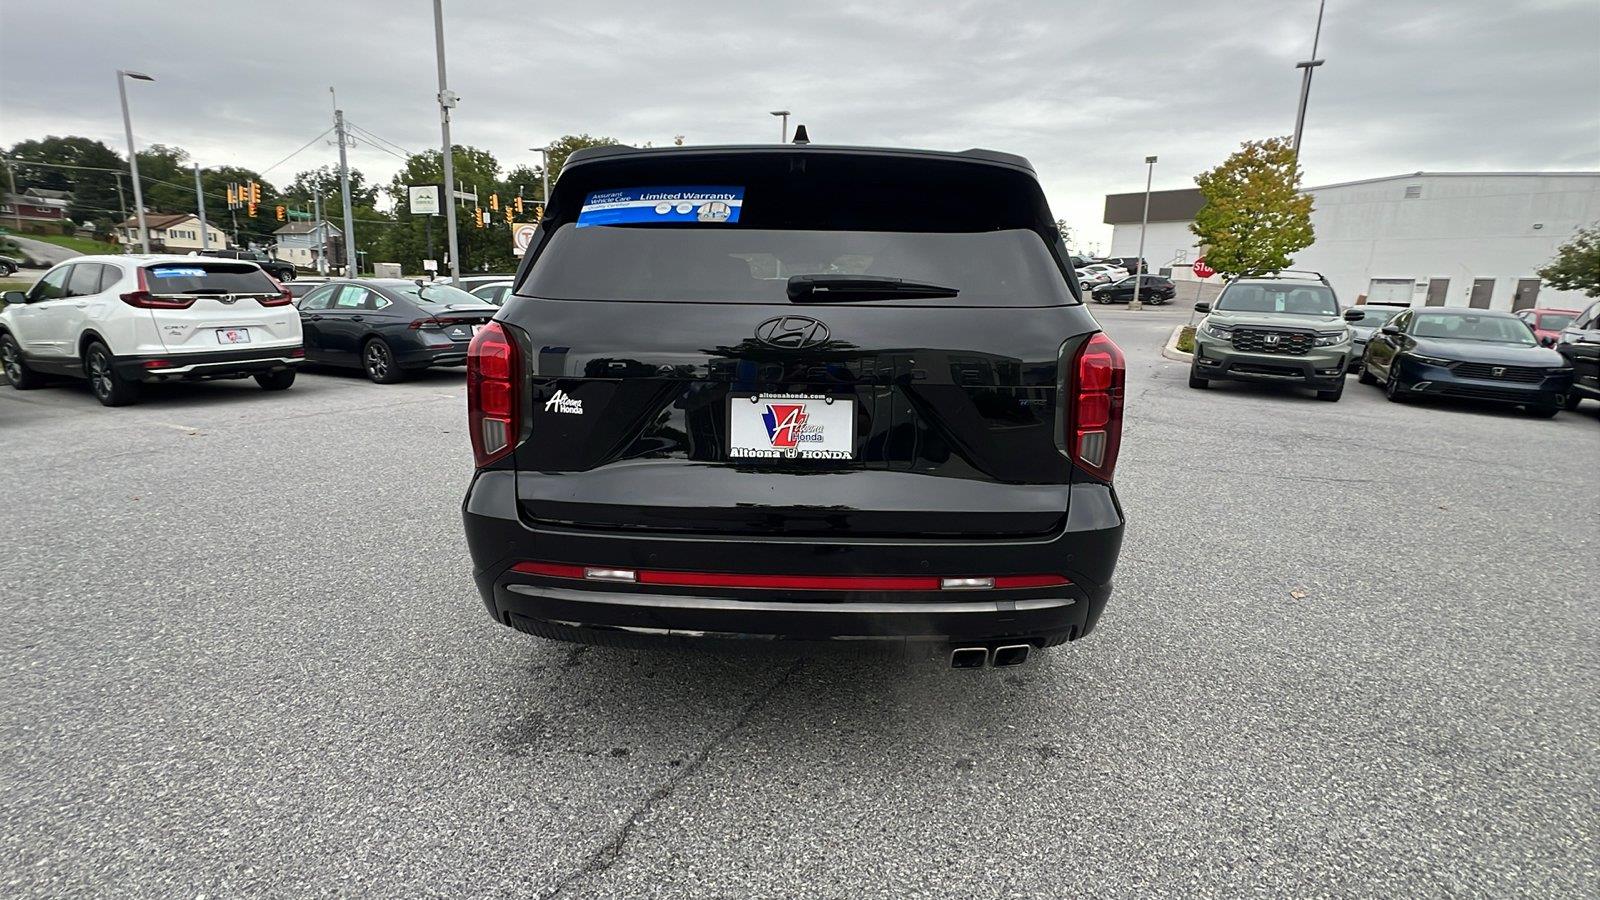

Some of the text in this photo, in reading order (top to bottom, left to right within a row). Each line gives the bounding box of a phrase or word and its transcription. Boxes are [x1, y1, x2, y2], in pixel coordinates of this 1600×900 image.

[592, 191, 623, 199] Assurant
[640, 192, 735, 200] Limited Warranty
[1194, 262, 1213, 272] STO
[560, 404, 583, 415] Honda
[791, 433, 824, 442] Honda
[730, 447, 780, 458] Altoona
[802, 450, 853, 460] HONDA
